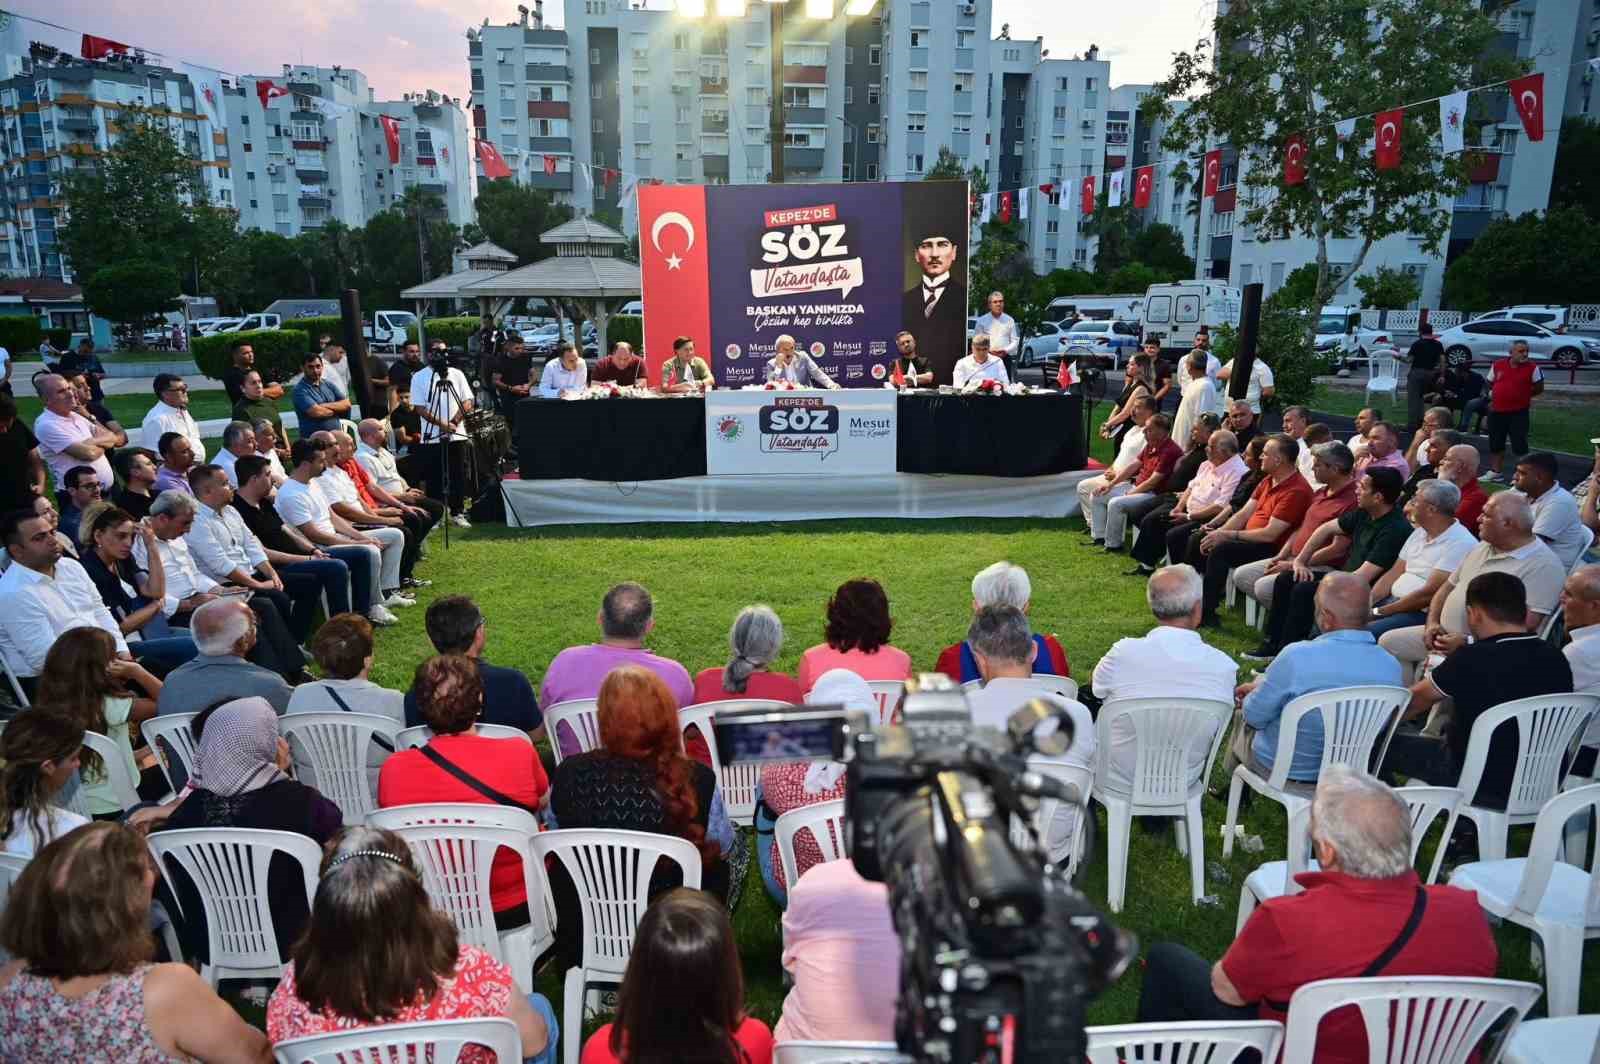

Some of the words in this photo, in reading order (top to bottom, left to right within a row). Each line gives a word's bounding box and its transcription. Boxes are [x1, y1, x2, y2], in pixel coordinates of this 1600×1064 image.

[770, 207, 831, 224] KEPEZ'DE
[761, 223, 848, 263] SÖZ
[764, 265, 851, 293] Vatandaşta
[746, 305, 796, 316] BAŞKAN
[799, 304, 865, 314] YANIMIZDA
[793, 314, 811, 328] hep
[815, 314, 854, 326] birlikte
[833, 341, 862, 350] Mesut
[726, 367, 754, 375] Mesut
[770, 408, 829, 431] SÖZ
[850, 417, 890, 428] Mesut
